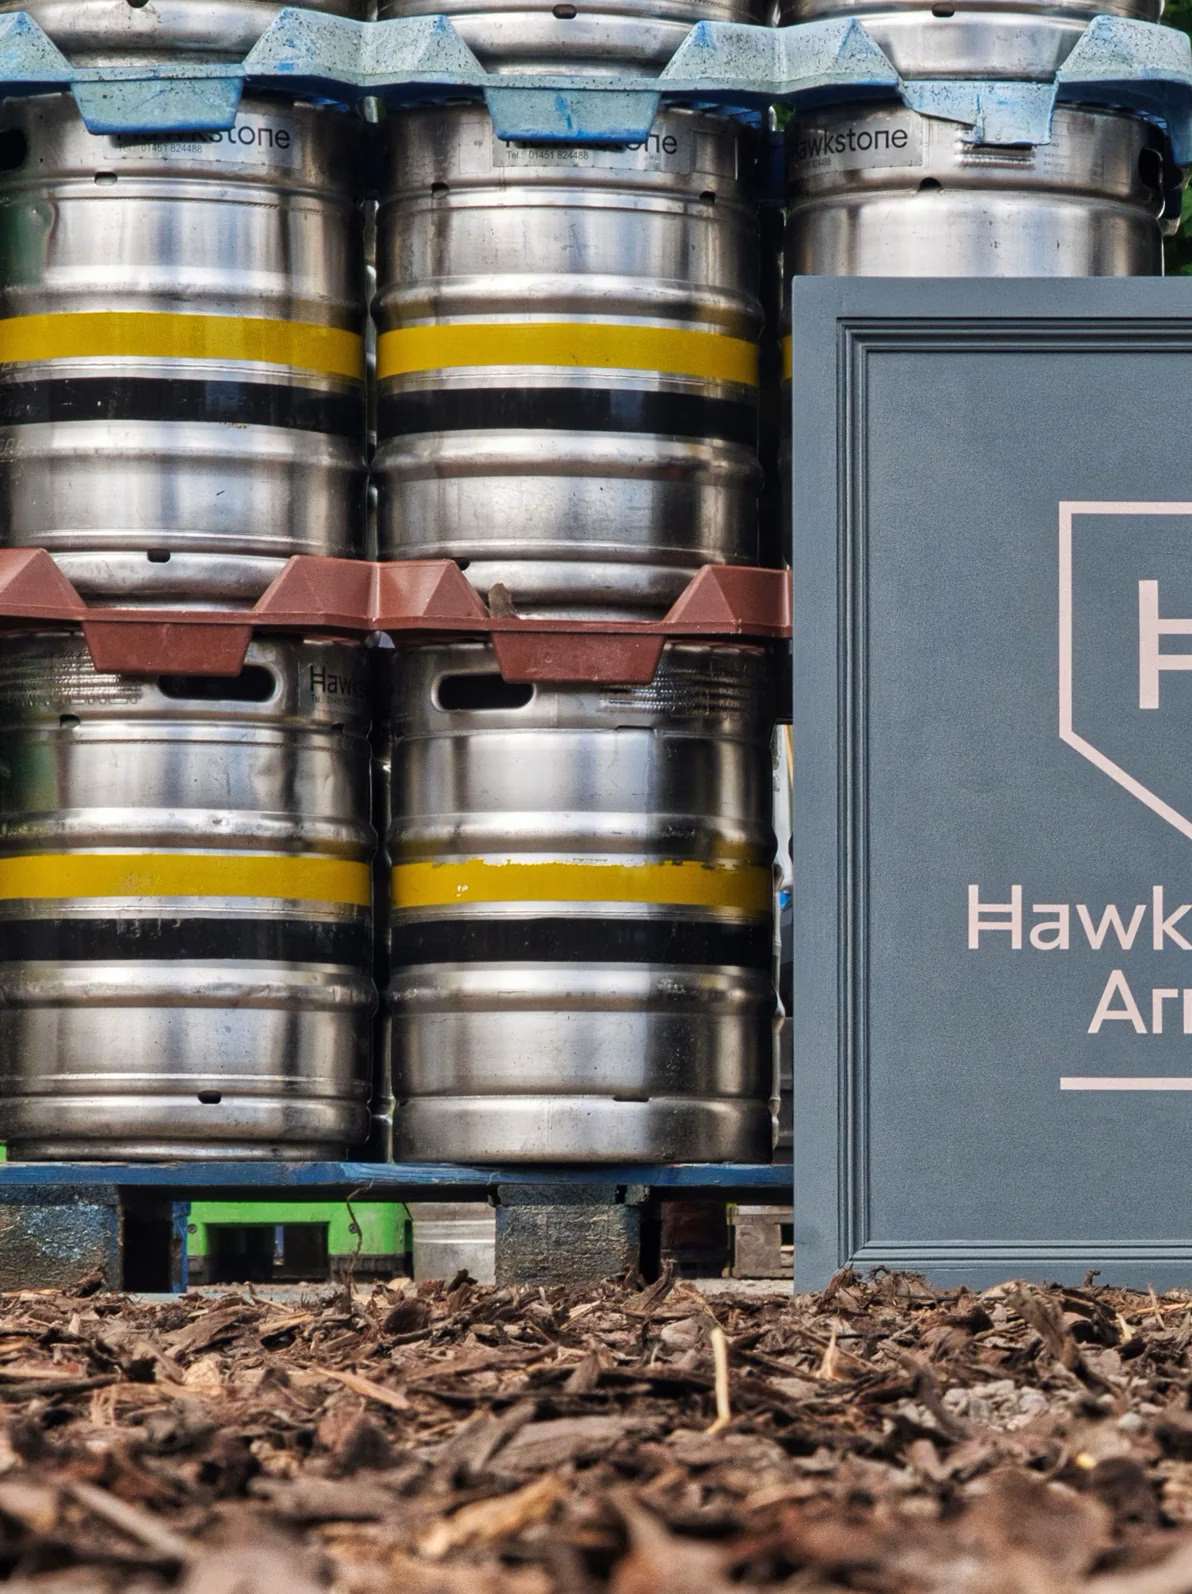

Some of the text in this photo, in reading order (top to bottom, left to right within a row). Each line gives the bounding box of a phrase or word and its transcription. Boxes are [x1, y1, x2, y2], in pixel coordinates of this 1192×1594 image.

[170, 144, 203, 154] 824488
[793, 128, 908, 160] awkstone
[528, 150, 555, 160] 01451
[557, 150, 589, 160] 824488
